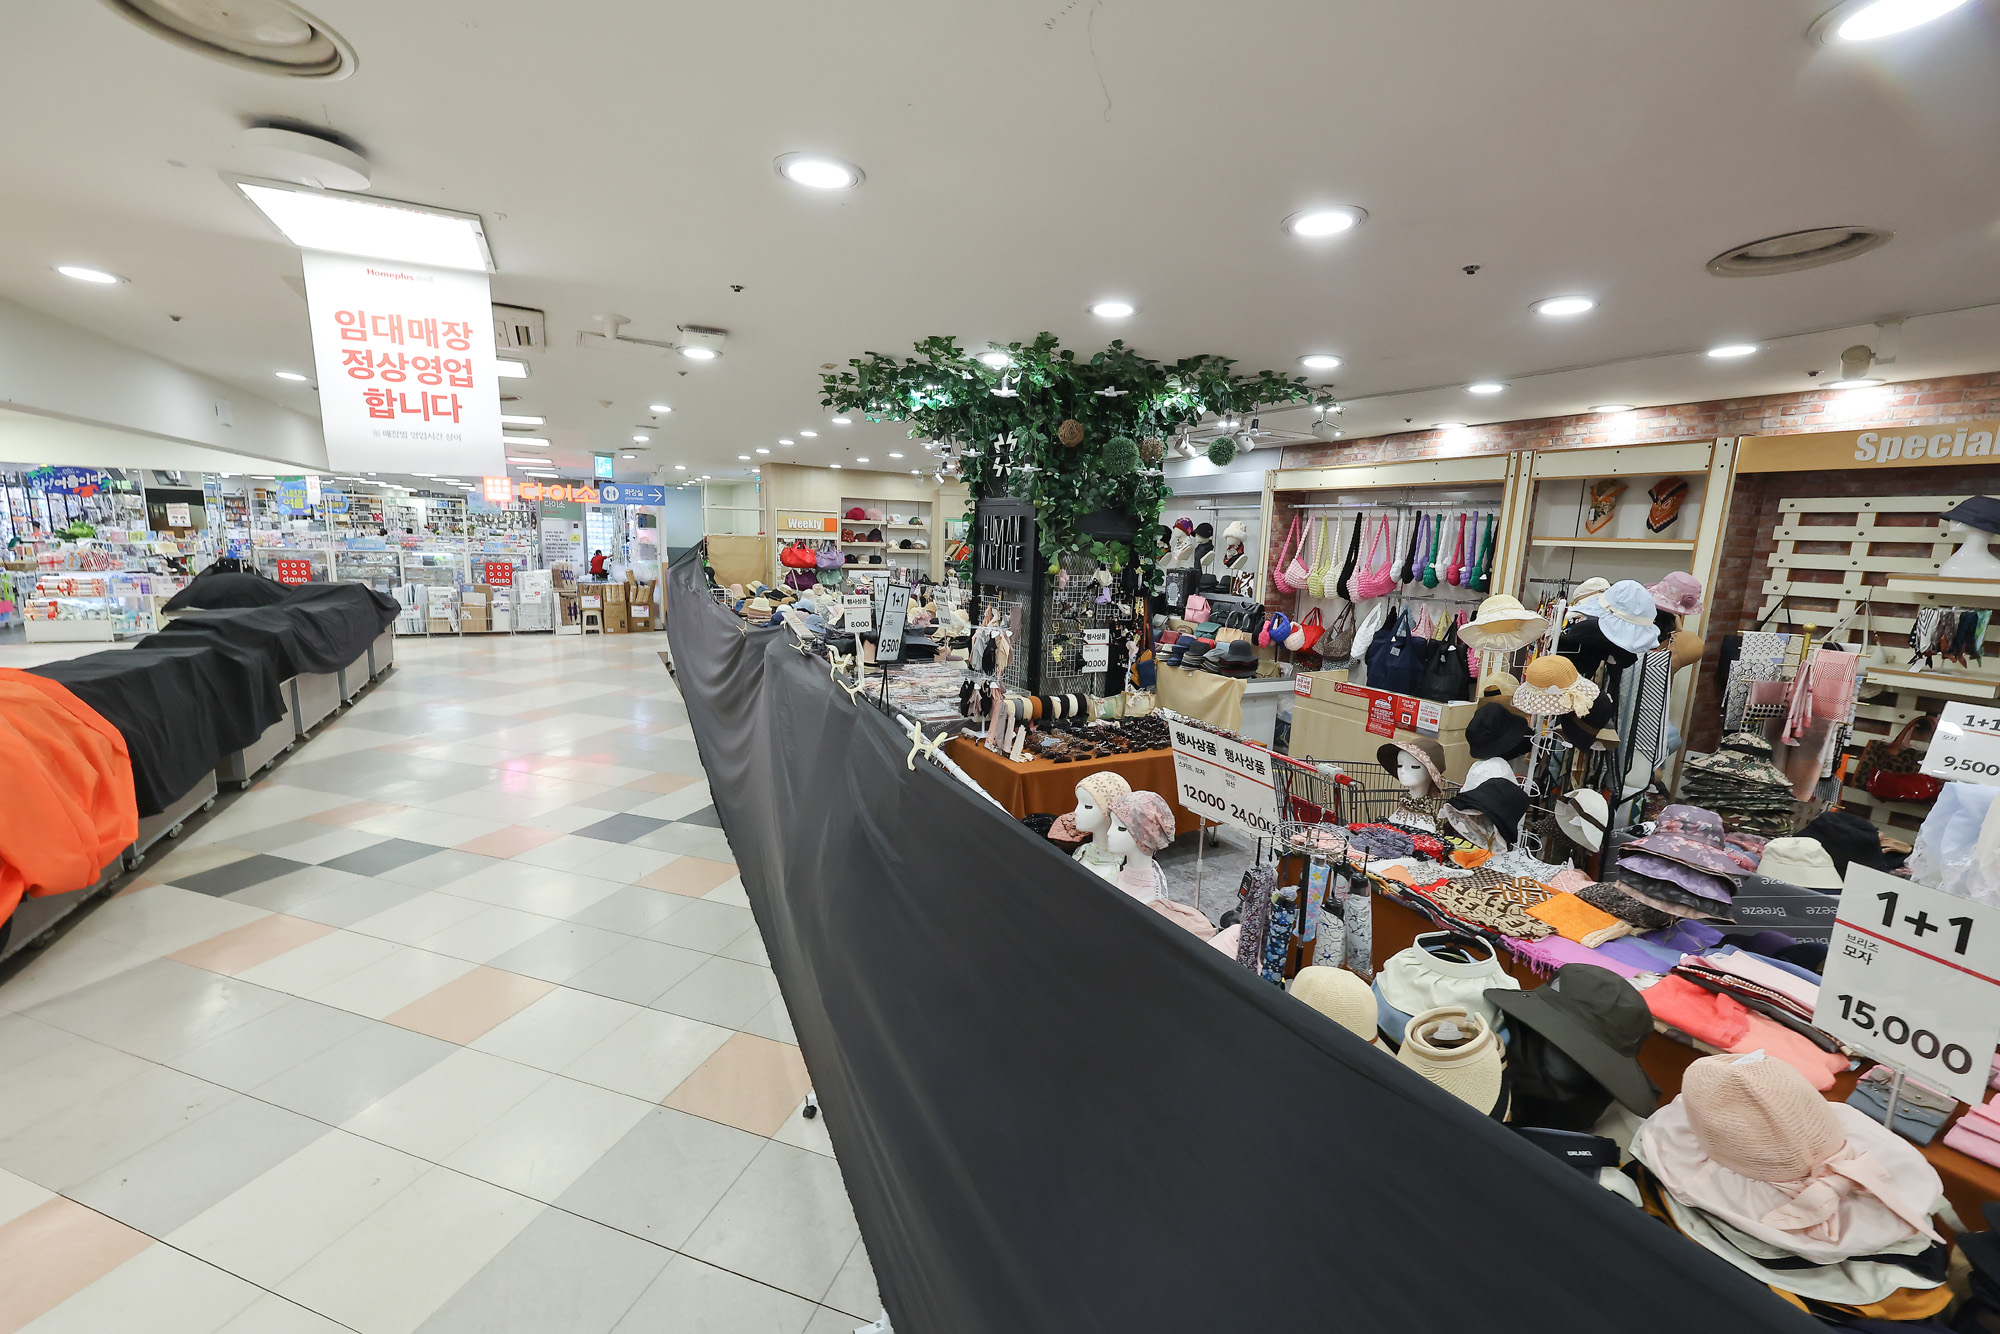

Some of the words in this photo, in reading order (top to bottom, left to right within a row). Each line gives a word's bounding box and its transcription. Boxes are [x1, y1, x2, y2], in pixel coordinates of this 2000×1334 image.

[367, 268, 414, 281] Homeplus
[334, 310, 473, 351] 임대매장
[342, 349, 473, 388] 정상영업
[363, 388, 463, 423] 합니다
[519, 482, 600, 503] 다이소
[624, 488, 644, 497] 화장실
[544, 500, 566, 508] 다이소
[788, 518, 822, 530] Weekly
[983, 515, 1021, 545] HUMAN
[980, 544, 1021, 572] NATURE
[282, 575, 308, 583] daiso
[489, 577, 511, 585] daiso
[876, 583, 886, 596] 1+1
[892, 592, 905, 607] 1+1
[1086, 632, 1107, 641] 행사상품
[881, 639, 900, 654] 9,500
[1963, 715, 2000, 731] 1+1
[1176, 731, 1217, 756] 행사상품
[1224, 748, 1266, 775] 행사상품
[1944, 756, 2000, 776] 9,500
[1184, 784, 1225, 811] 12,000
[1741, 906, 1787, 917] Breeze
[1876, 891, 1974, 955] 1+1
[1846, 934, 1879, 953] 브리즈
[1843, 945, 1873, 966] 모자
[1838, 994, 1972, 1075] 15,000
